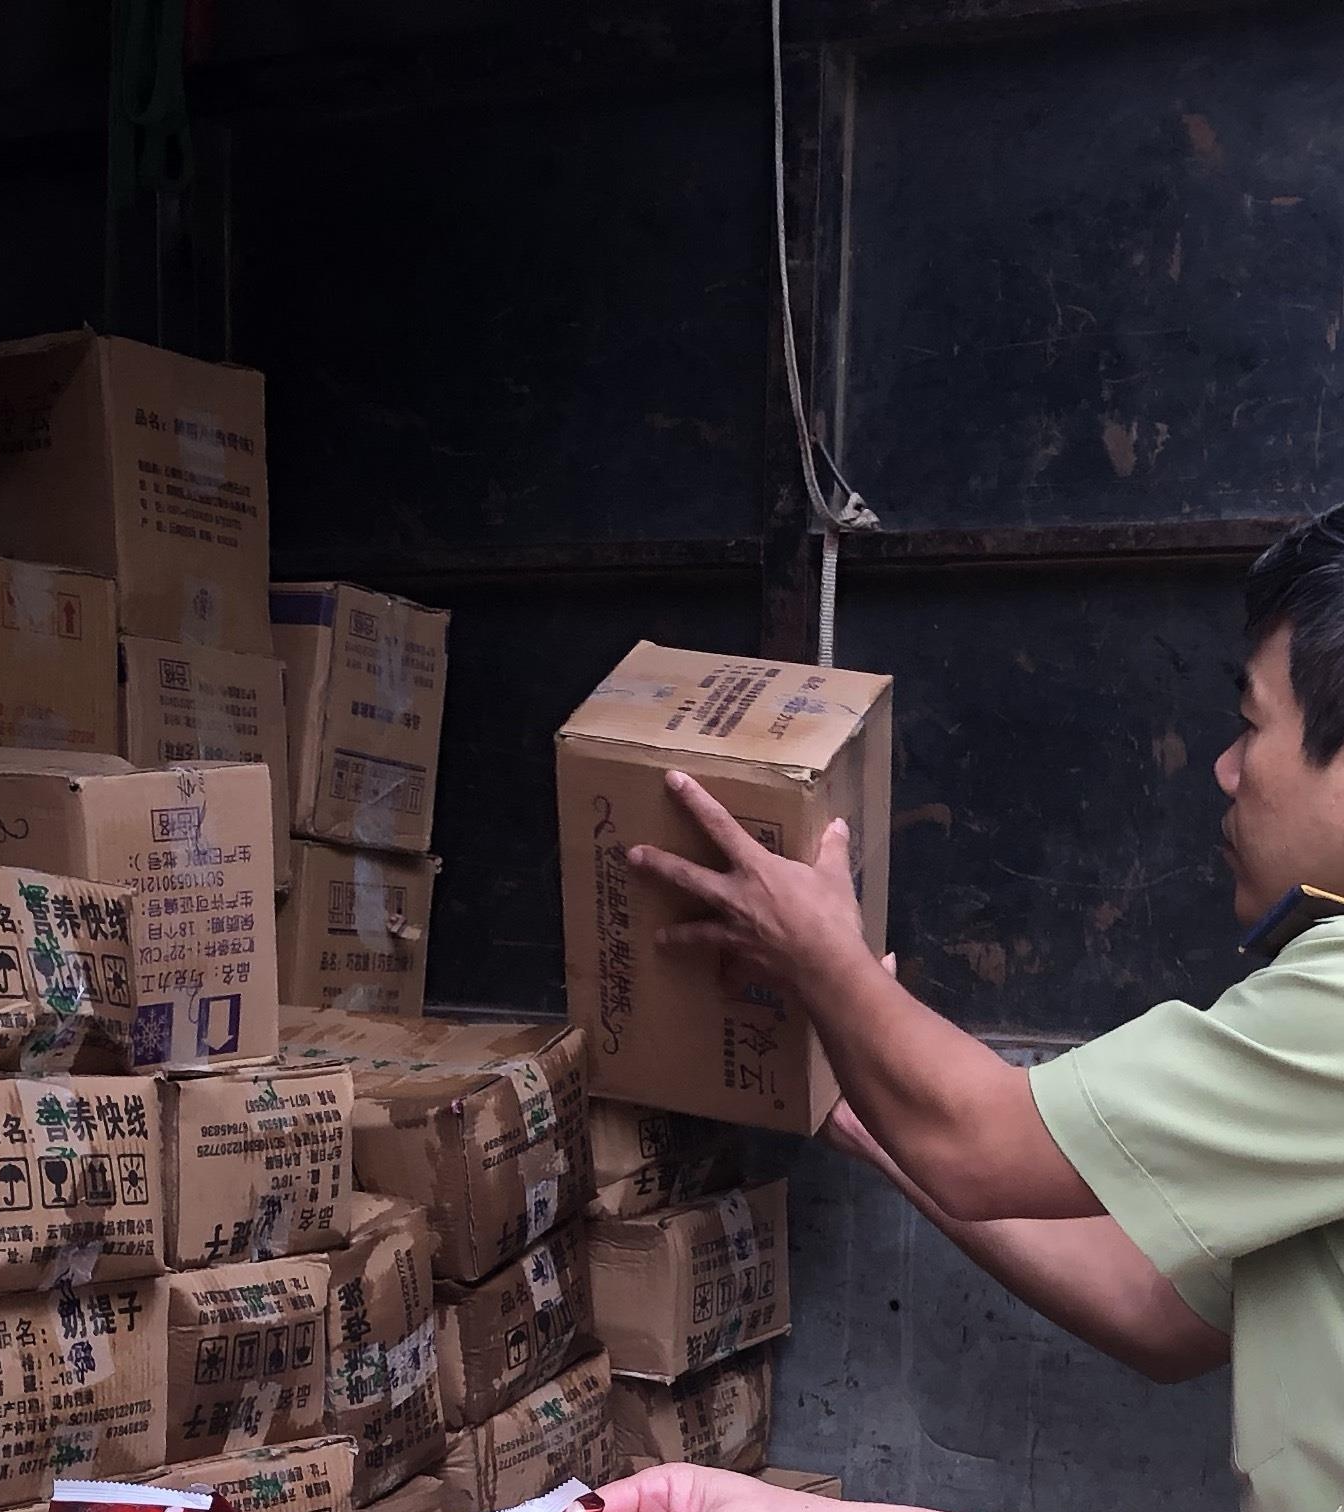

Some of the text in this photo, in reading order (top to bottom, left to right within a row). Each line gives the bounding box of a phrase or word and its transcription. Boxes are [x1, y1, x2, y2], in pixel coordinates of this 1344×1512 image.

[147, 921, 195, 940] 18个月
[136, 961, 250, 993] 品名： 巧克力工
[738, 1022, 778, 1096] 冷云
[290, 1205, 334, 1232] 品名：
